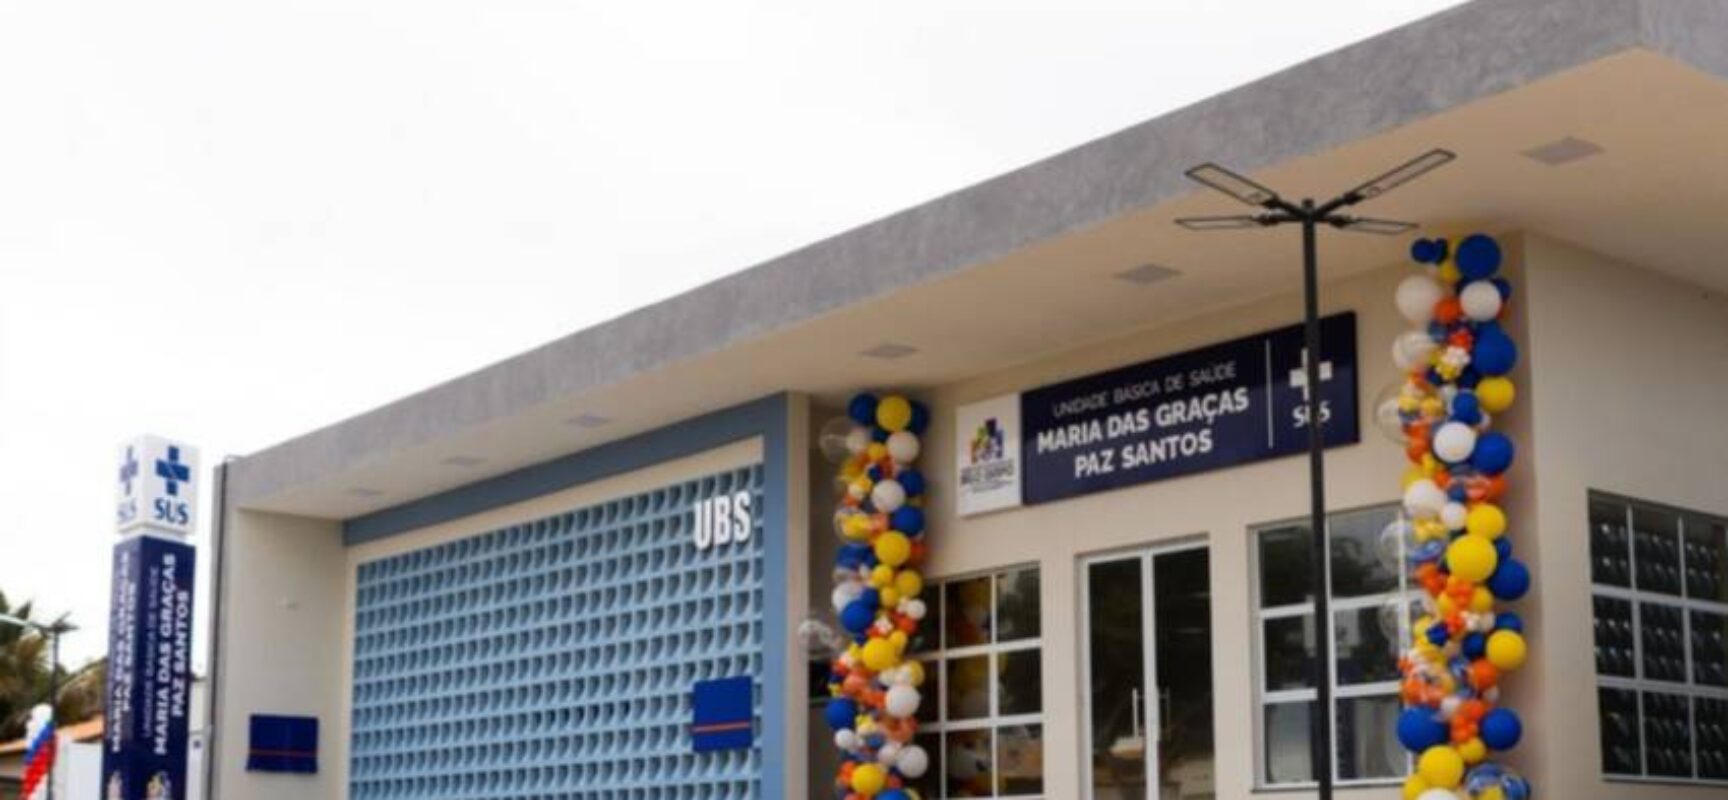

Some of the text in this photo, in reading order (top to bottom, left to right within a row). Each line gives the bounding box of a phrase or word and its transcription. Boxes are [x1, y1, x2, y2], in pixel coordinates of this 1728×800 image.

[1053, 390, 1108, 417] UNIDADE
[1165, 375, 1184, 391] DE
[1188, 361, 1237, 387] SAÚDE
[1037, 387, 1250, 454] MARIA DAS GRAÇAS
[1074, 429, 1214, 479] PAZ SANTOS
[154, 497, 189, 525] SUS
[694, 490, 752, 549] UBS
[155, 553, 176, 755] MARIA DAS GRAÇAS
[172, 590, 188, 718] PAZ SANTOS
